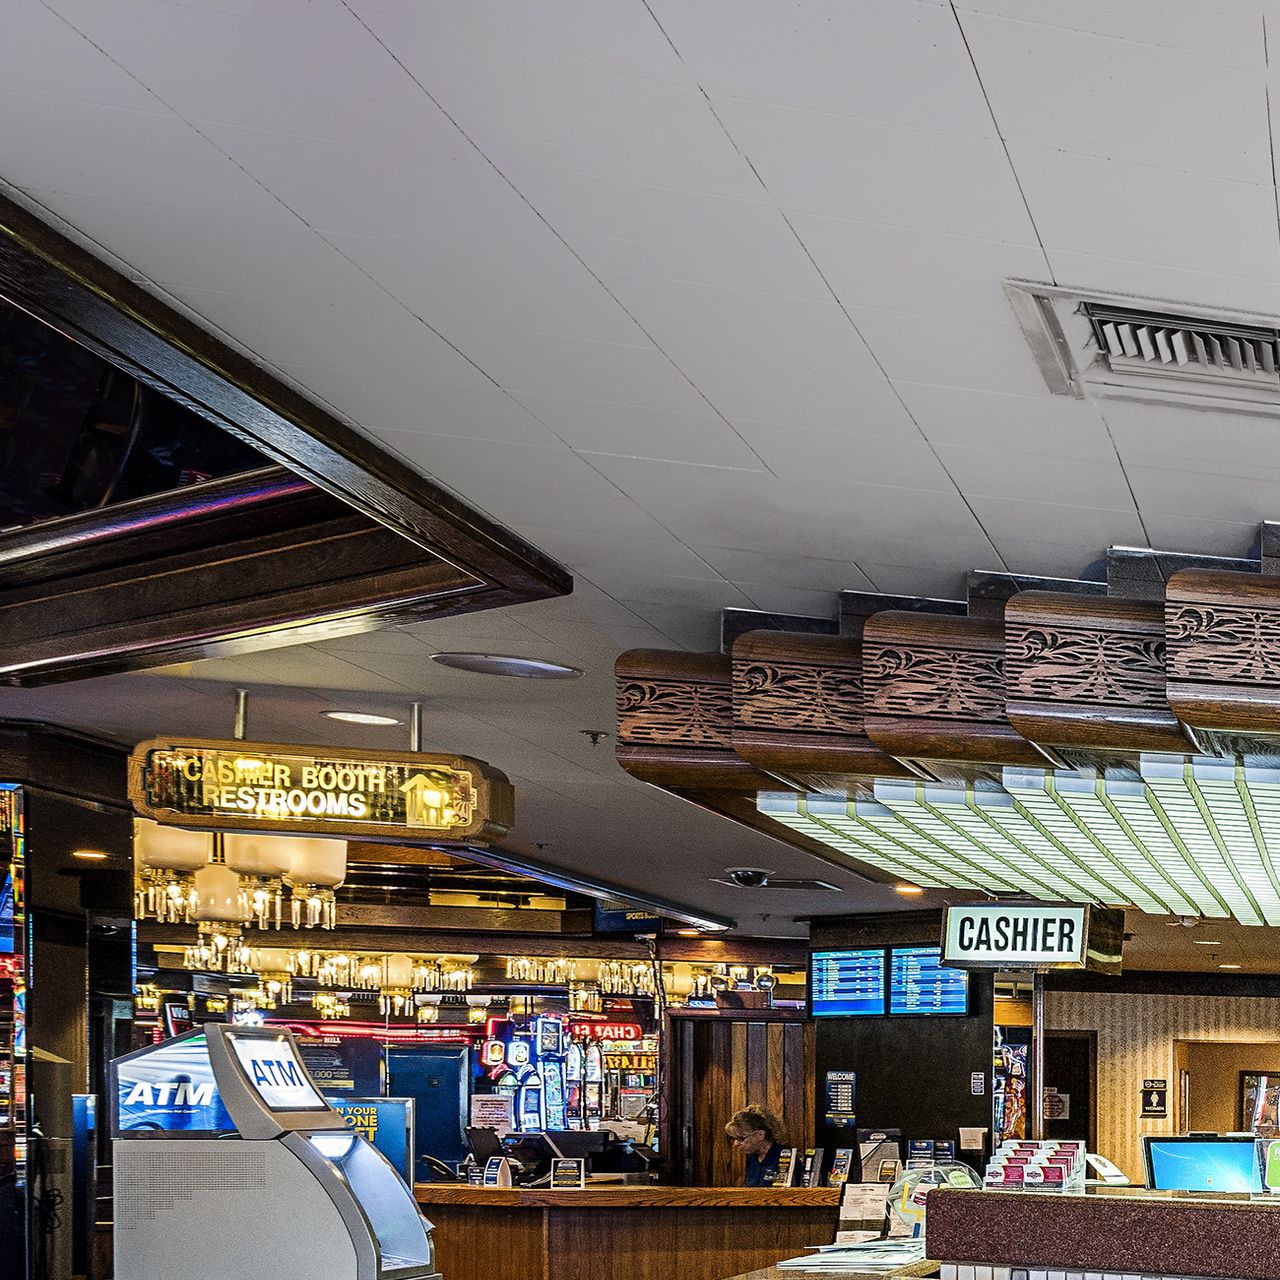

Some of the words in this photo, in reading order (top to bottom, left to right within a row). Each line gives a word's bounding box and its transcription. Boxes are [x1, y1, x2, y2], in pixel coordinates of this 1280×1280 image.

[184, 758, 291, 788] CASHIER
[302, 766, 385, 792] BOOTH
[203, 786, 366, 817] RESTROOMS
[958, 916, 1076, 953] CASHIER
[252, 1059, 305, 1087] ATM
[827, 1073, 854, 1081] WELCOME
[124, 1083, 216, 1106] ATM
[347, 1107, 377, 1115] YOUR
